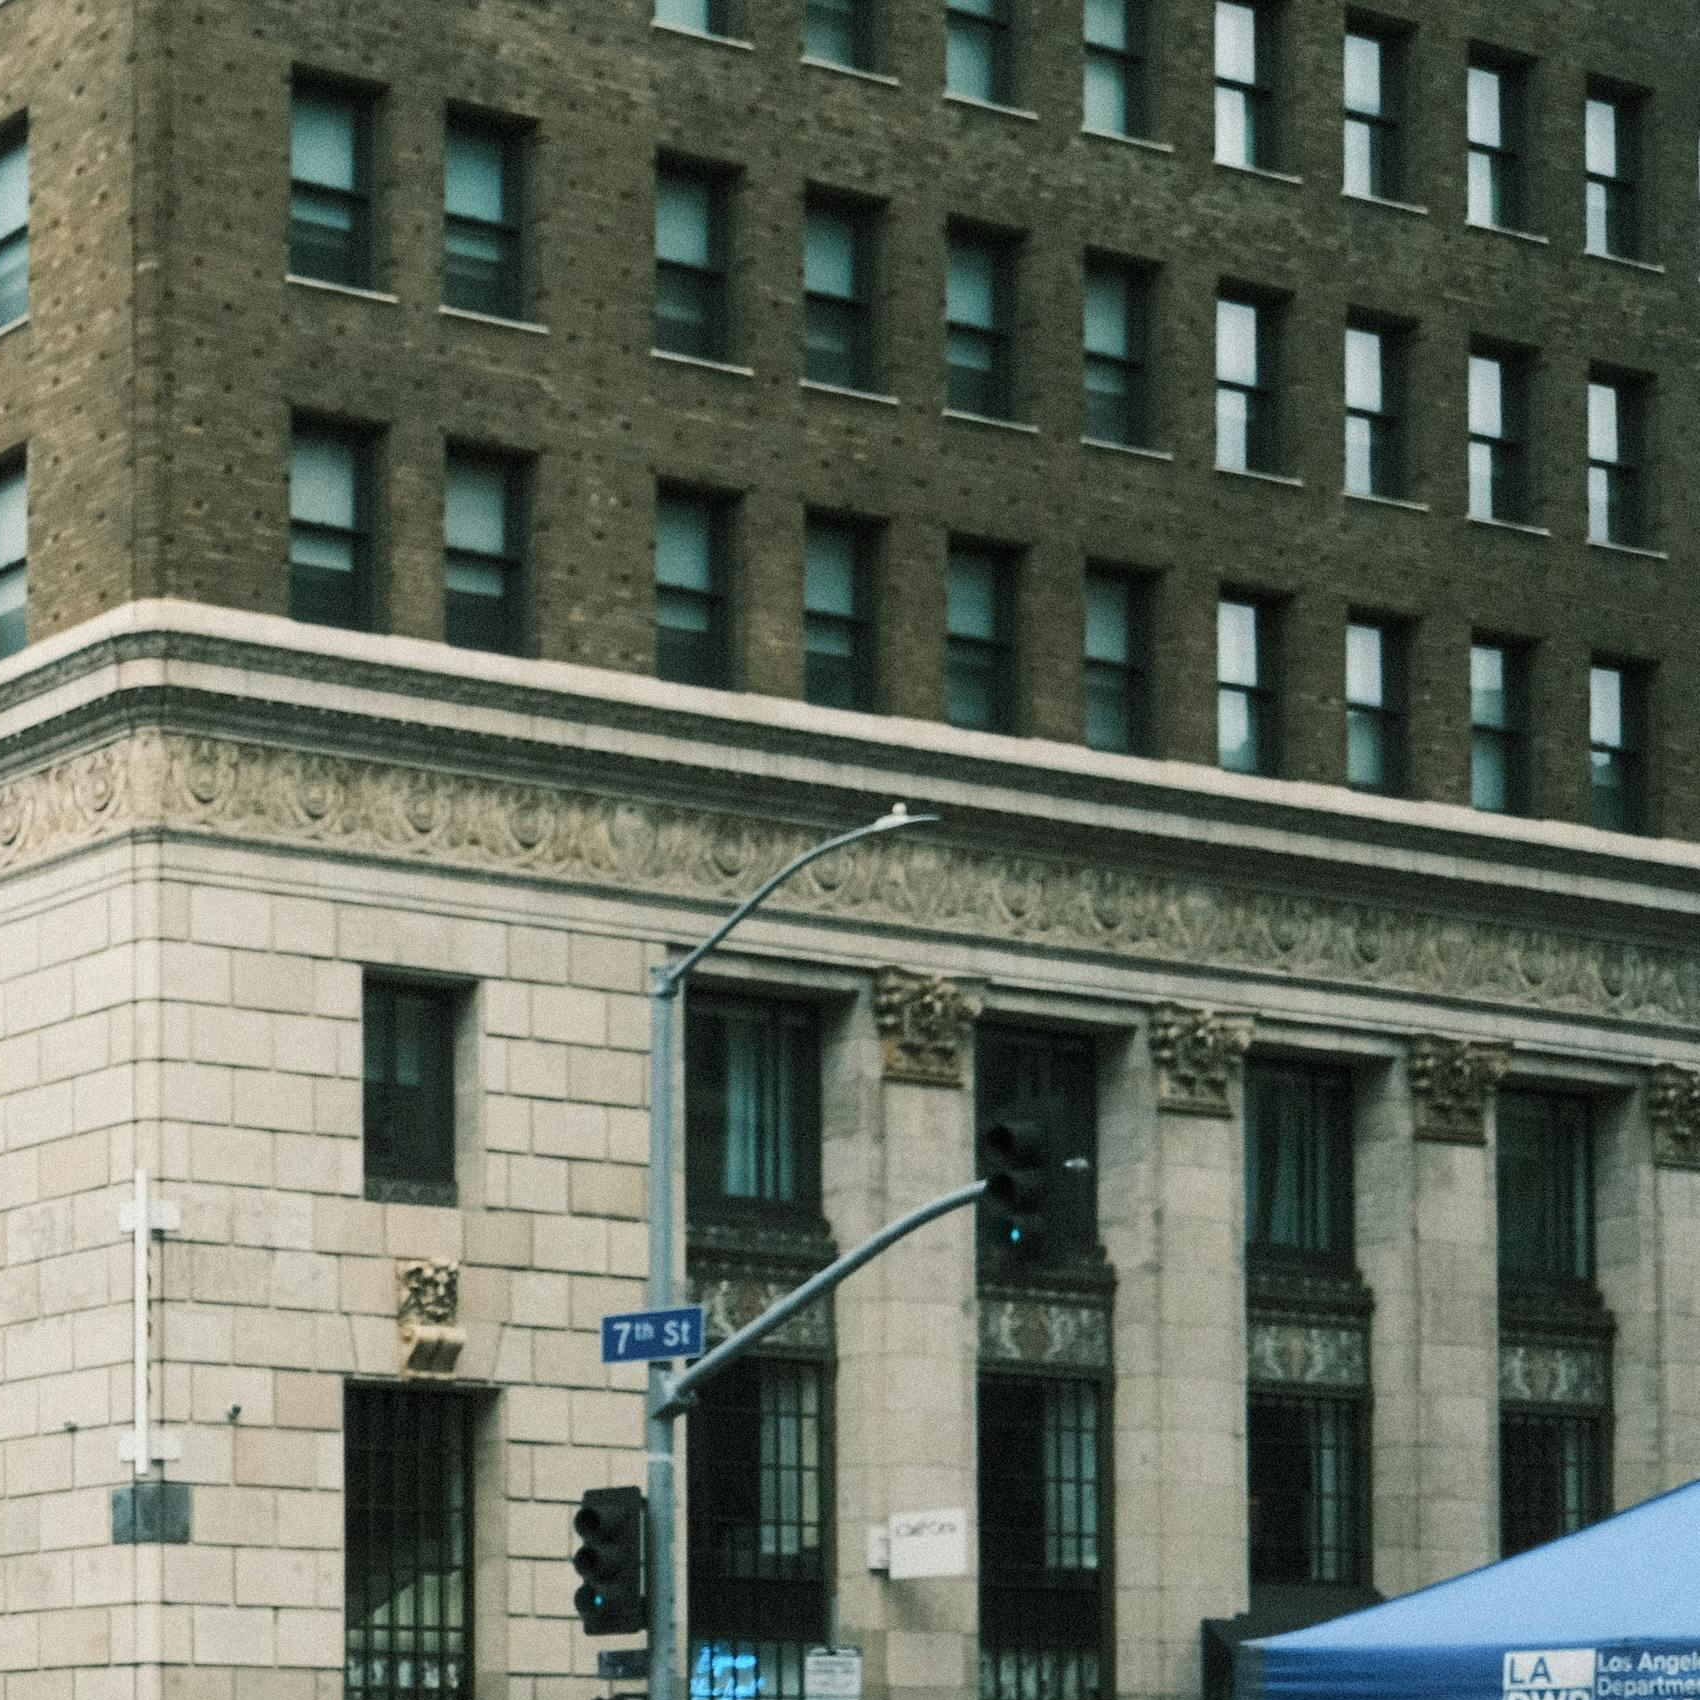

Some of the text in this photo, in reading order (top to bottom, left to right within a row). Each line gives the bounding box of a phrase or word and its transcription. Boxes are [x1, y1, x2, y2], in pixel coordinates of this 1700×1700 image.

[612, 1319, 691, 1355] 7th St
[1510, 1656, 1552, 1685] LA
[1600, 1653, 1633, 1673] Los
